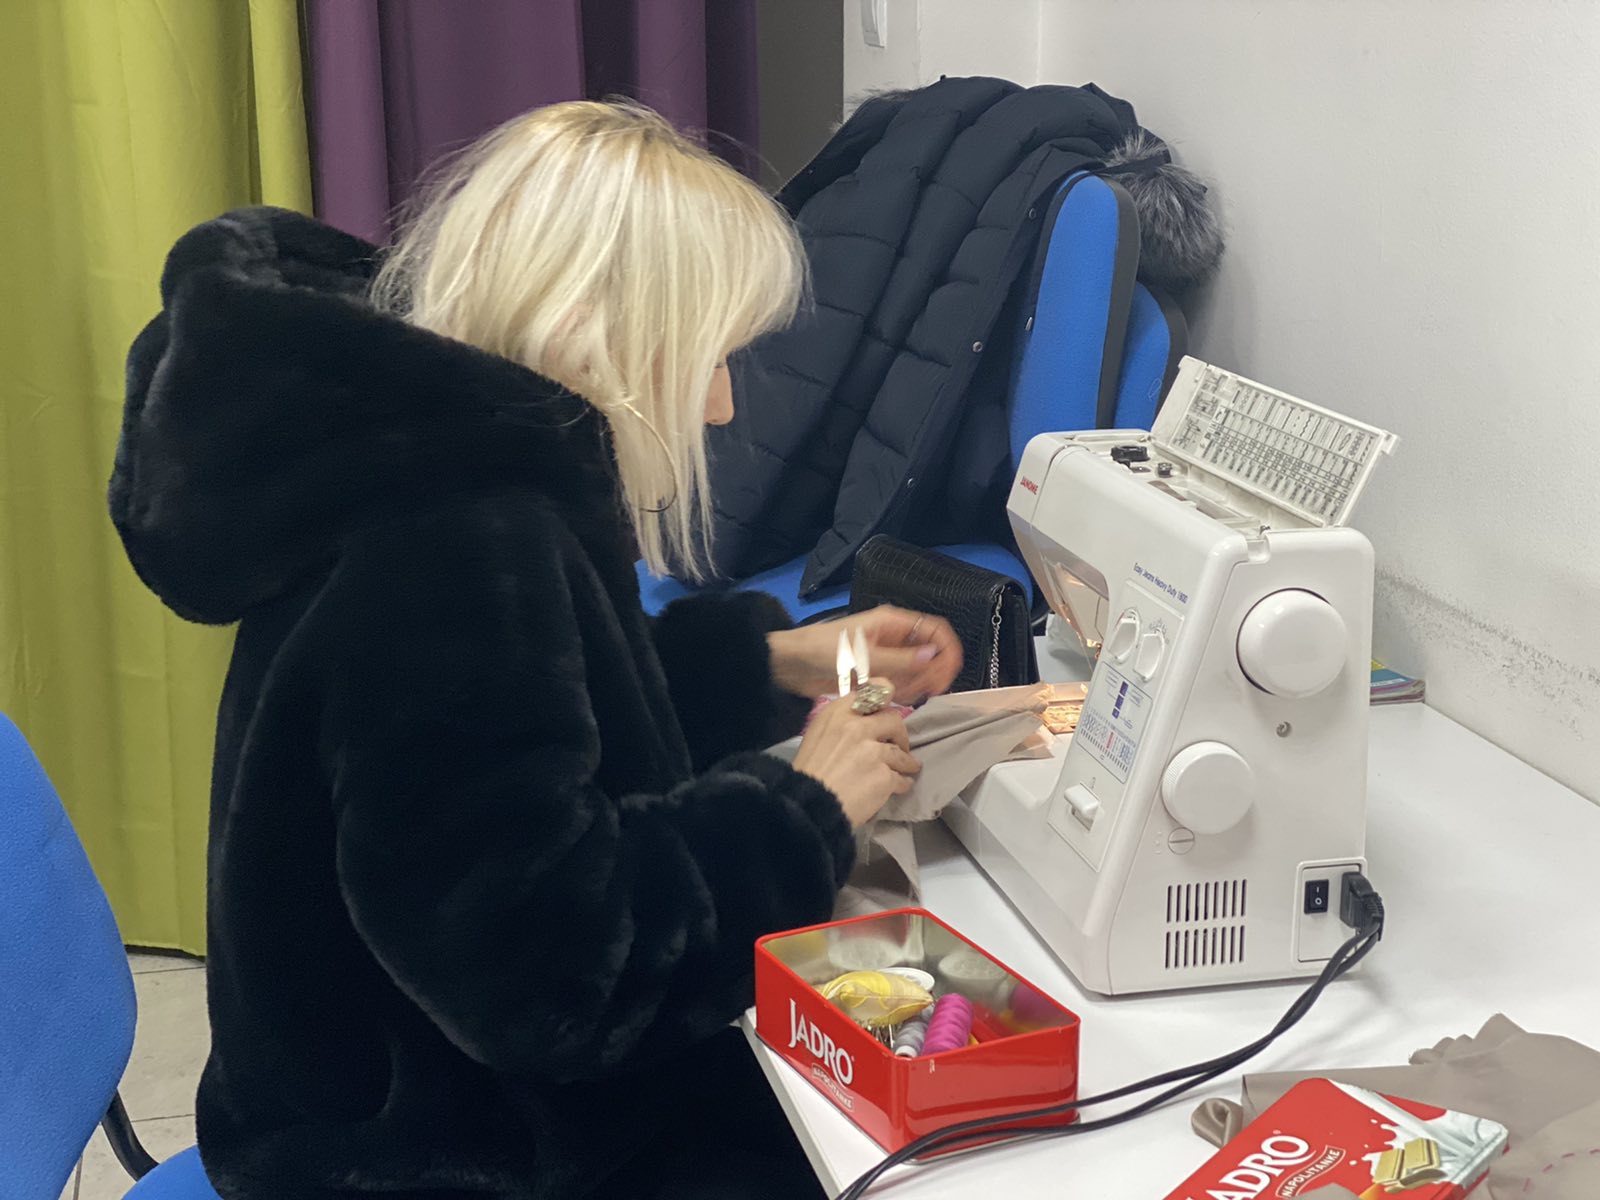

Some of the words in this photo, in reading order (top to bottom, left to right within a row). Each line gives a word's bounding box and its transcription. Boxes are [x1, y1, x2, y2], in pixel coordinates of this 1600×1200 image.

[788, 998, 853, 1088] JADRO
[1184, 1135, 1316, 1200] ADRO
[1281, 1149, 1340, 1198] NAPOLITANKE
